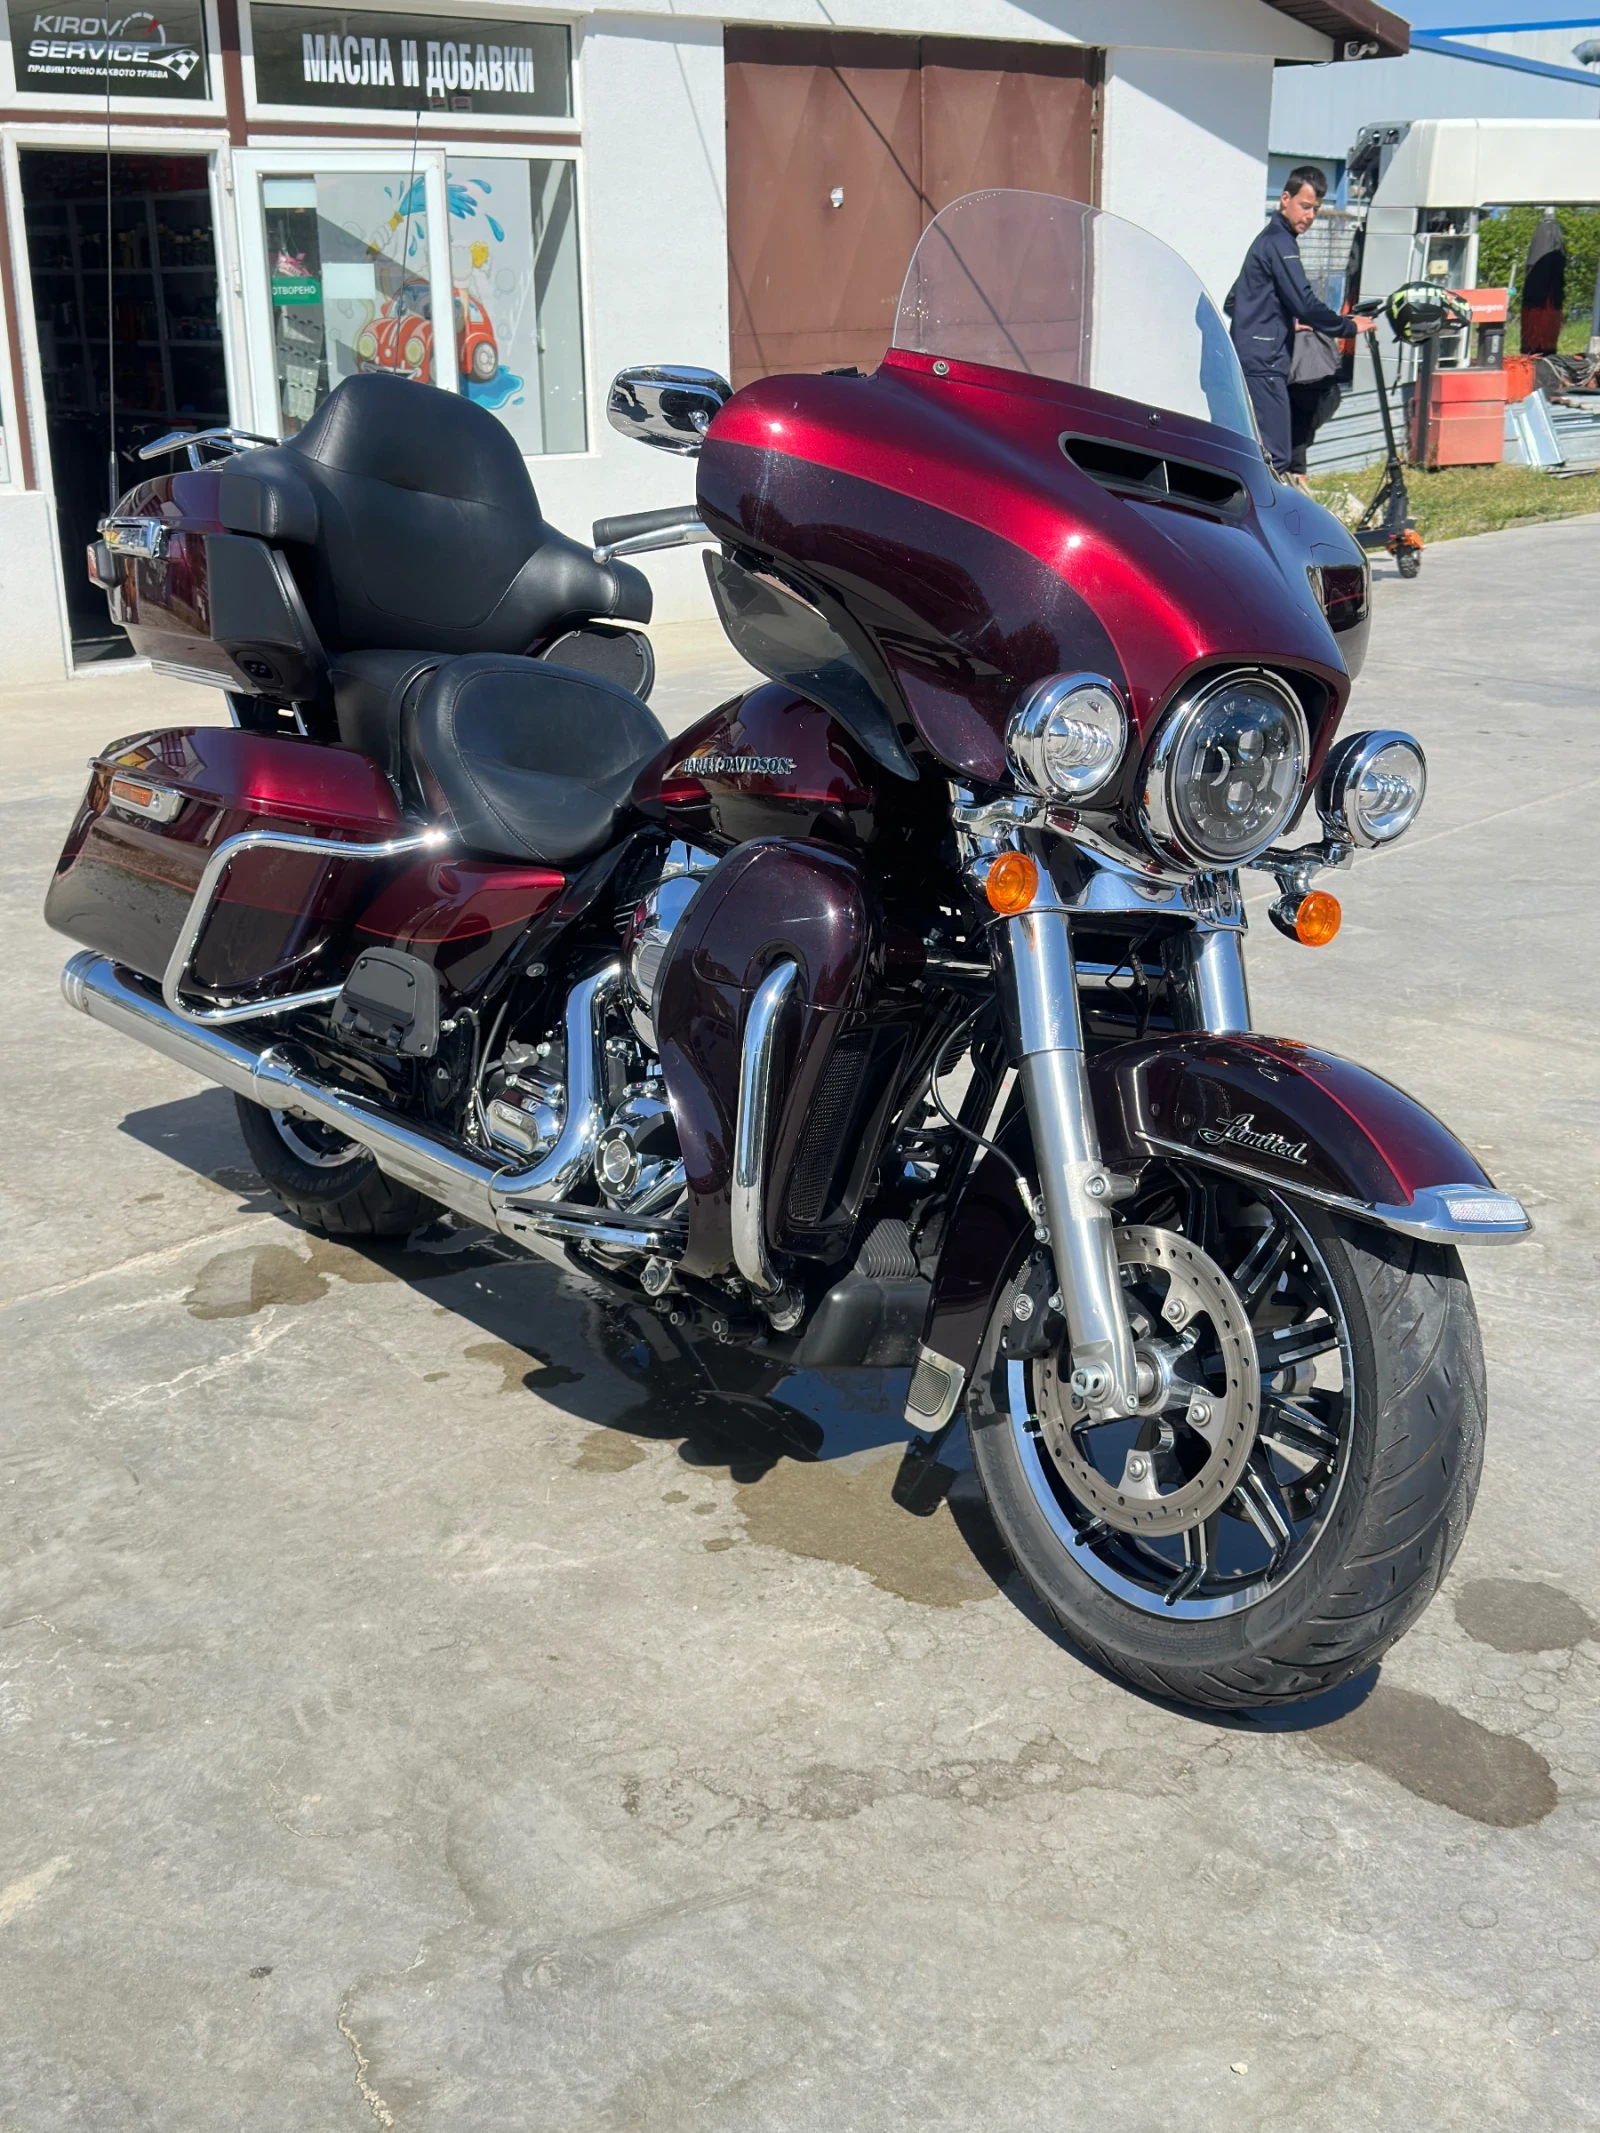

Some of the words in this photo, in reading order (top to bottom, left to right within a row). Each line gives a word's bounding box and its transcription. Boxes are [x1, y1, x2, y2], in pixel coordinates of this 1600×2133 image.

[33, 15, 122, 36] KIROV
[28, 40, 150, 62] SERVICE
[28, 65, 65, 74] ПРАВИМ
[65, 66, 95, 75] ТОЧНО
[302, 33, 395, 86] МАСЛА
[401, 39, 420, 87] И
[426, 41, 534, 98] ДОБАВКИ
[1198, 1113, 1308, 1165] Limited
